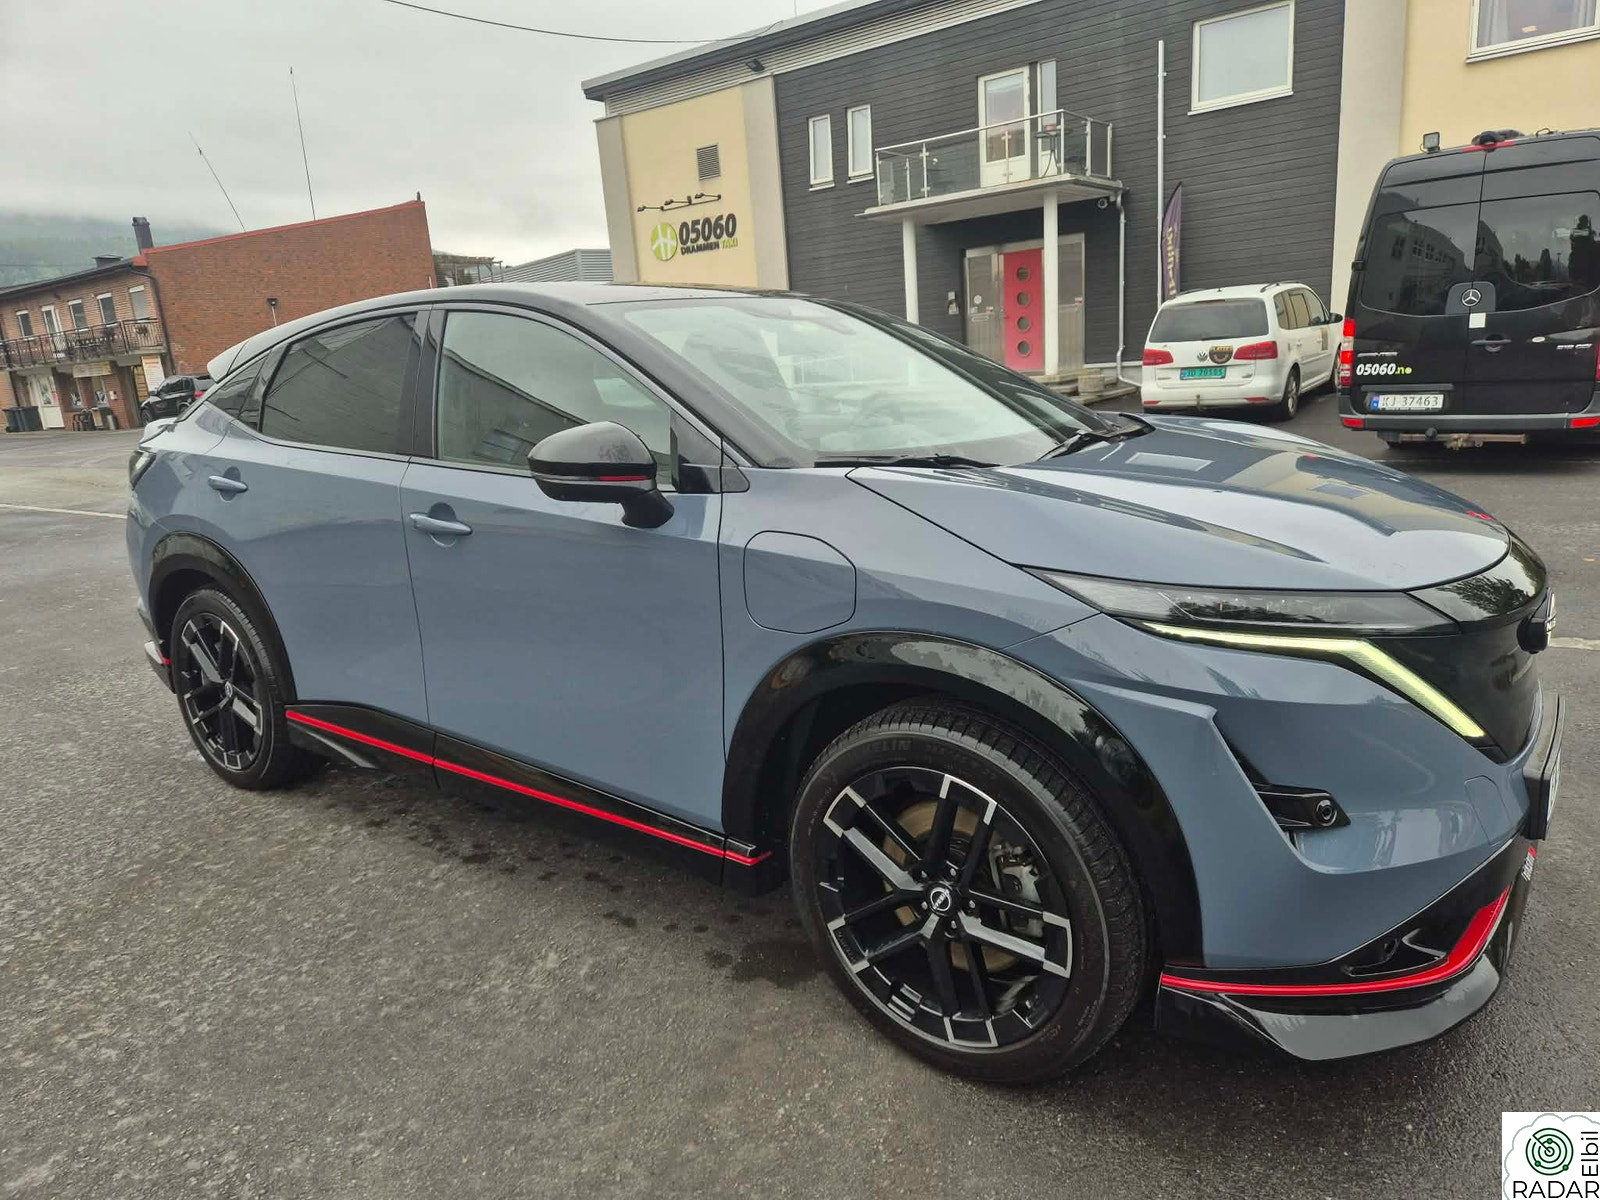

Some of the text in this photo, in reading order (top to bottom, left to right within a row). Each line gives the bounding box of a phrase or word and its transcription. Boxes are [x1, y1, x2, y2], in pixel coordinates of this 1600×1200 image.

[679, 213, 736, 245] 05060
[681, 241, 720, 255] DRAMMEN
[1382, 396, 1439, 407] KJ 37463
